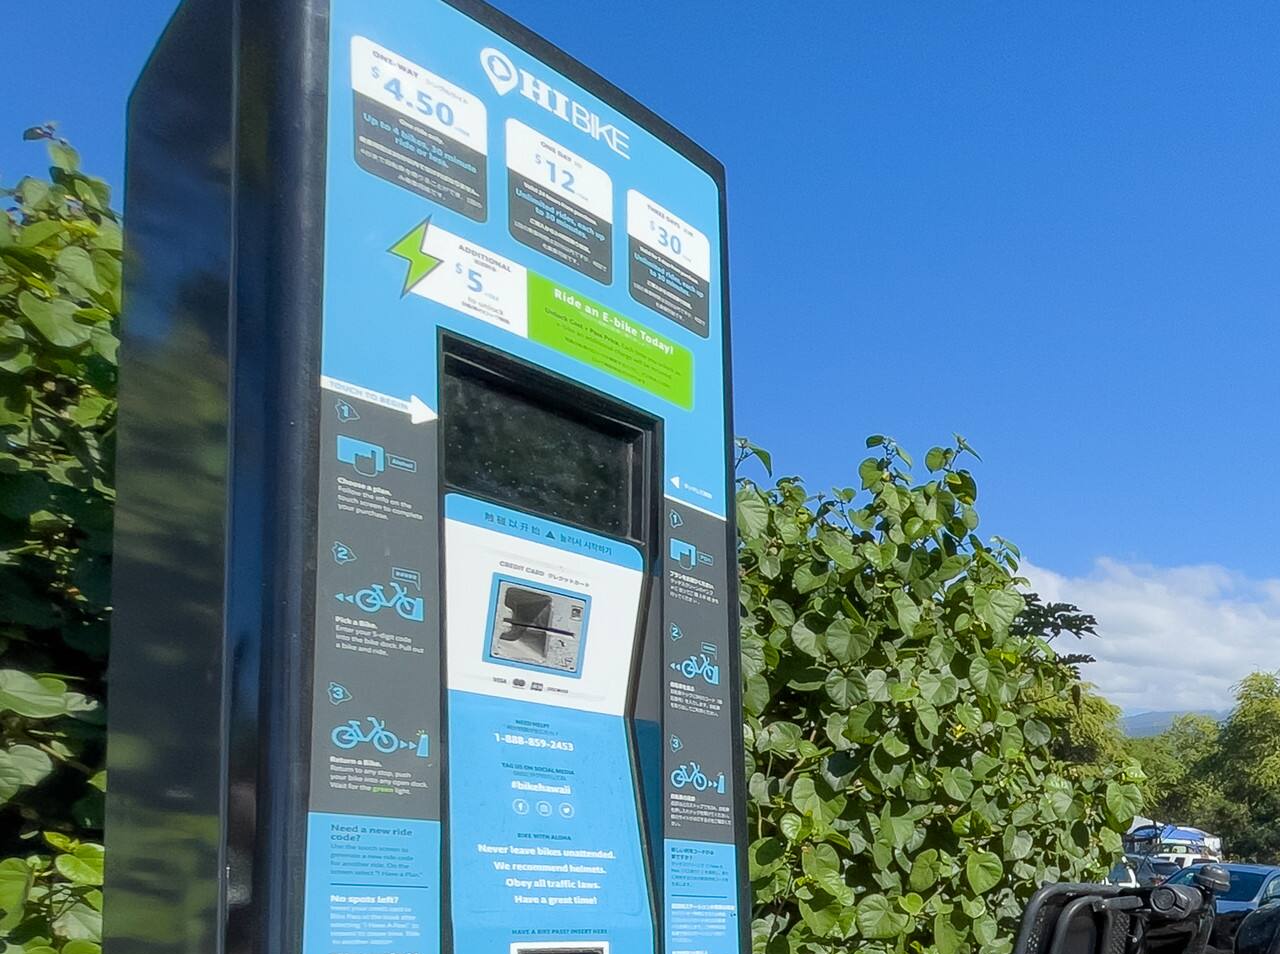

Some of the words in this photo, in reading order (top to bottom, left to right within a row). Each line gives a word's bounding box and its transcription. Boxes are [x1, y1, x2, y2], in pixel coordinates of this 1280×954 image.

[519, 68, 631, 160] HIBIKE
[363, 112, 380, 128] Up
[380, 121, 392, 132] to
[458, 244, 511, 273] ADDITIONAL
[554, 288, 582, 311] Ride
[584, 304, 599, 319] an
[602, 311, 639, 338] E-bike
[640, 330, 674, 356] Today!
[338, 547, 348, 559] 2
[499, 560, 525, 572] CREDIT
[525, 567, 545, 577] CARD
[671, 626, 679, 638] 2
[332, 687, 344, 700] 3
[493, 732, 575, 752] 1-888-859-2453
[671, 738, 679, 749] 3
[511, 780, 572, 795] #bikehawaii
[331, 824, 359, 833] Need
[368, 827, 391, 835] new
[392, 828, 413, 837] ride
[330, 833, 361, 842] code?
[477, 843, 509, 854] Never
[510, 845, 536, 856] leave
[537, 846, 562, 857] bikes
[563, 849, 616, 859] unattended.
[493, 861, 511, 871] We
[512, 862, 569, 873] recommend
[569, 864, 607, 874] helmets.
[505, 878, 533, 890] Obey
[534, 878, 546, 888] all
[546, 879, 576, 889] traffic
[577, 880, 601, 889] laws.
[330, 894, 347, 904] No
[348, 896, 376, 905] spots
[513, 895, 541, 904] Have
[548, 897, 574, 906] great
[573, 895, 598, 905] time!
